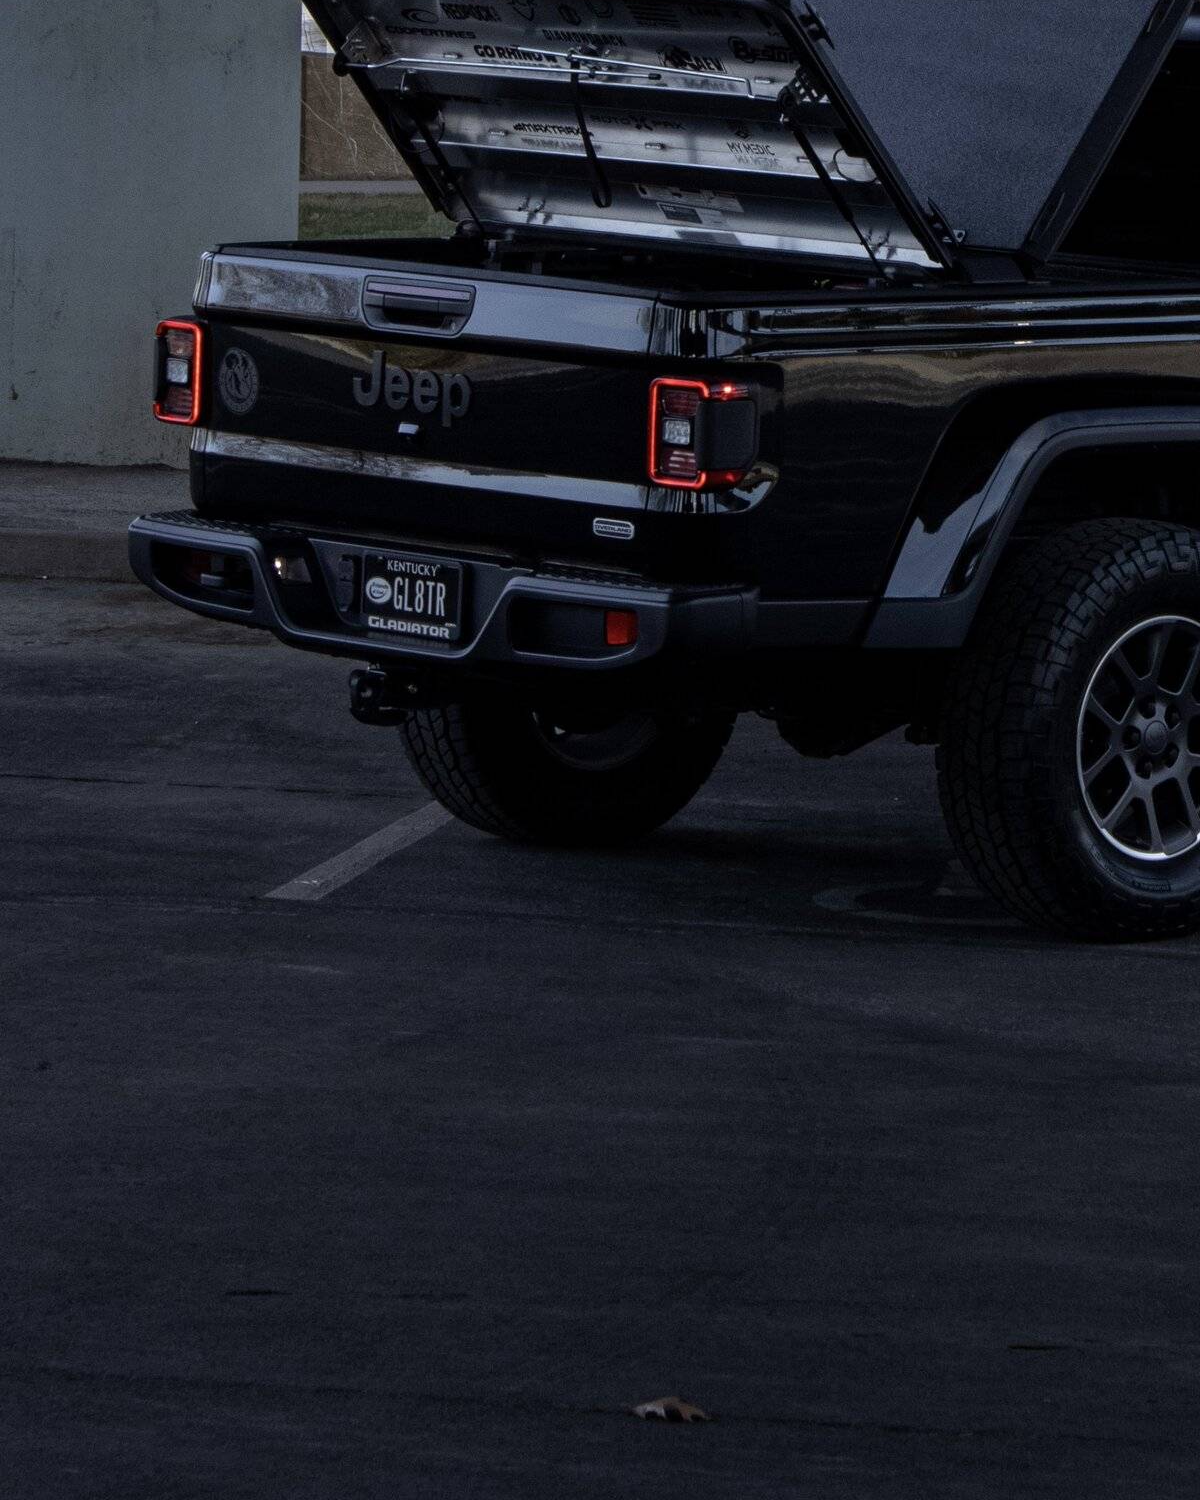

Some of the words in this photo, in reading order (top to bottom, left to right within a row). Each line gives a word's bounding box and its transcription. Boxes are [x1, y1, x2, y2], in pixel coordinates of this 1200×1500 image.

[352, 349, 471, 428] Jeep
[387, 559, 440, 577] KENTUCKY
[393, 576, 447, 617] GL8TR
[367, 615, 450, 639] GLADIATOR
